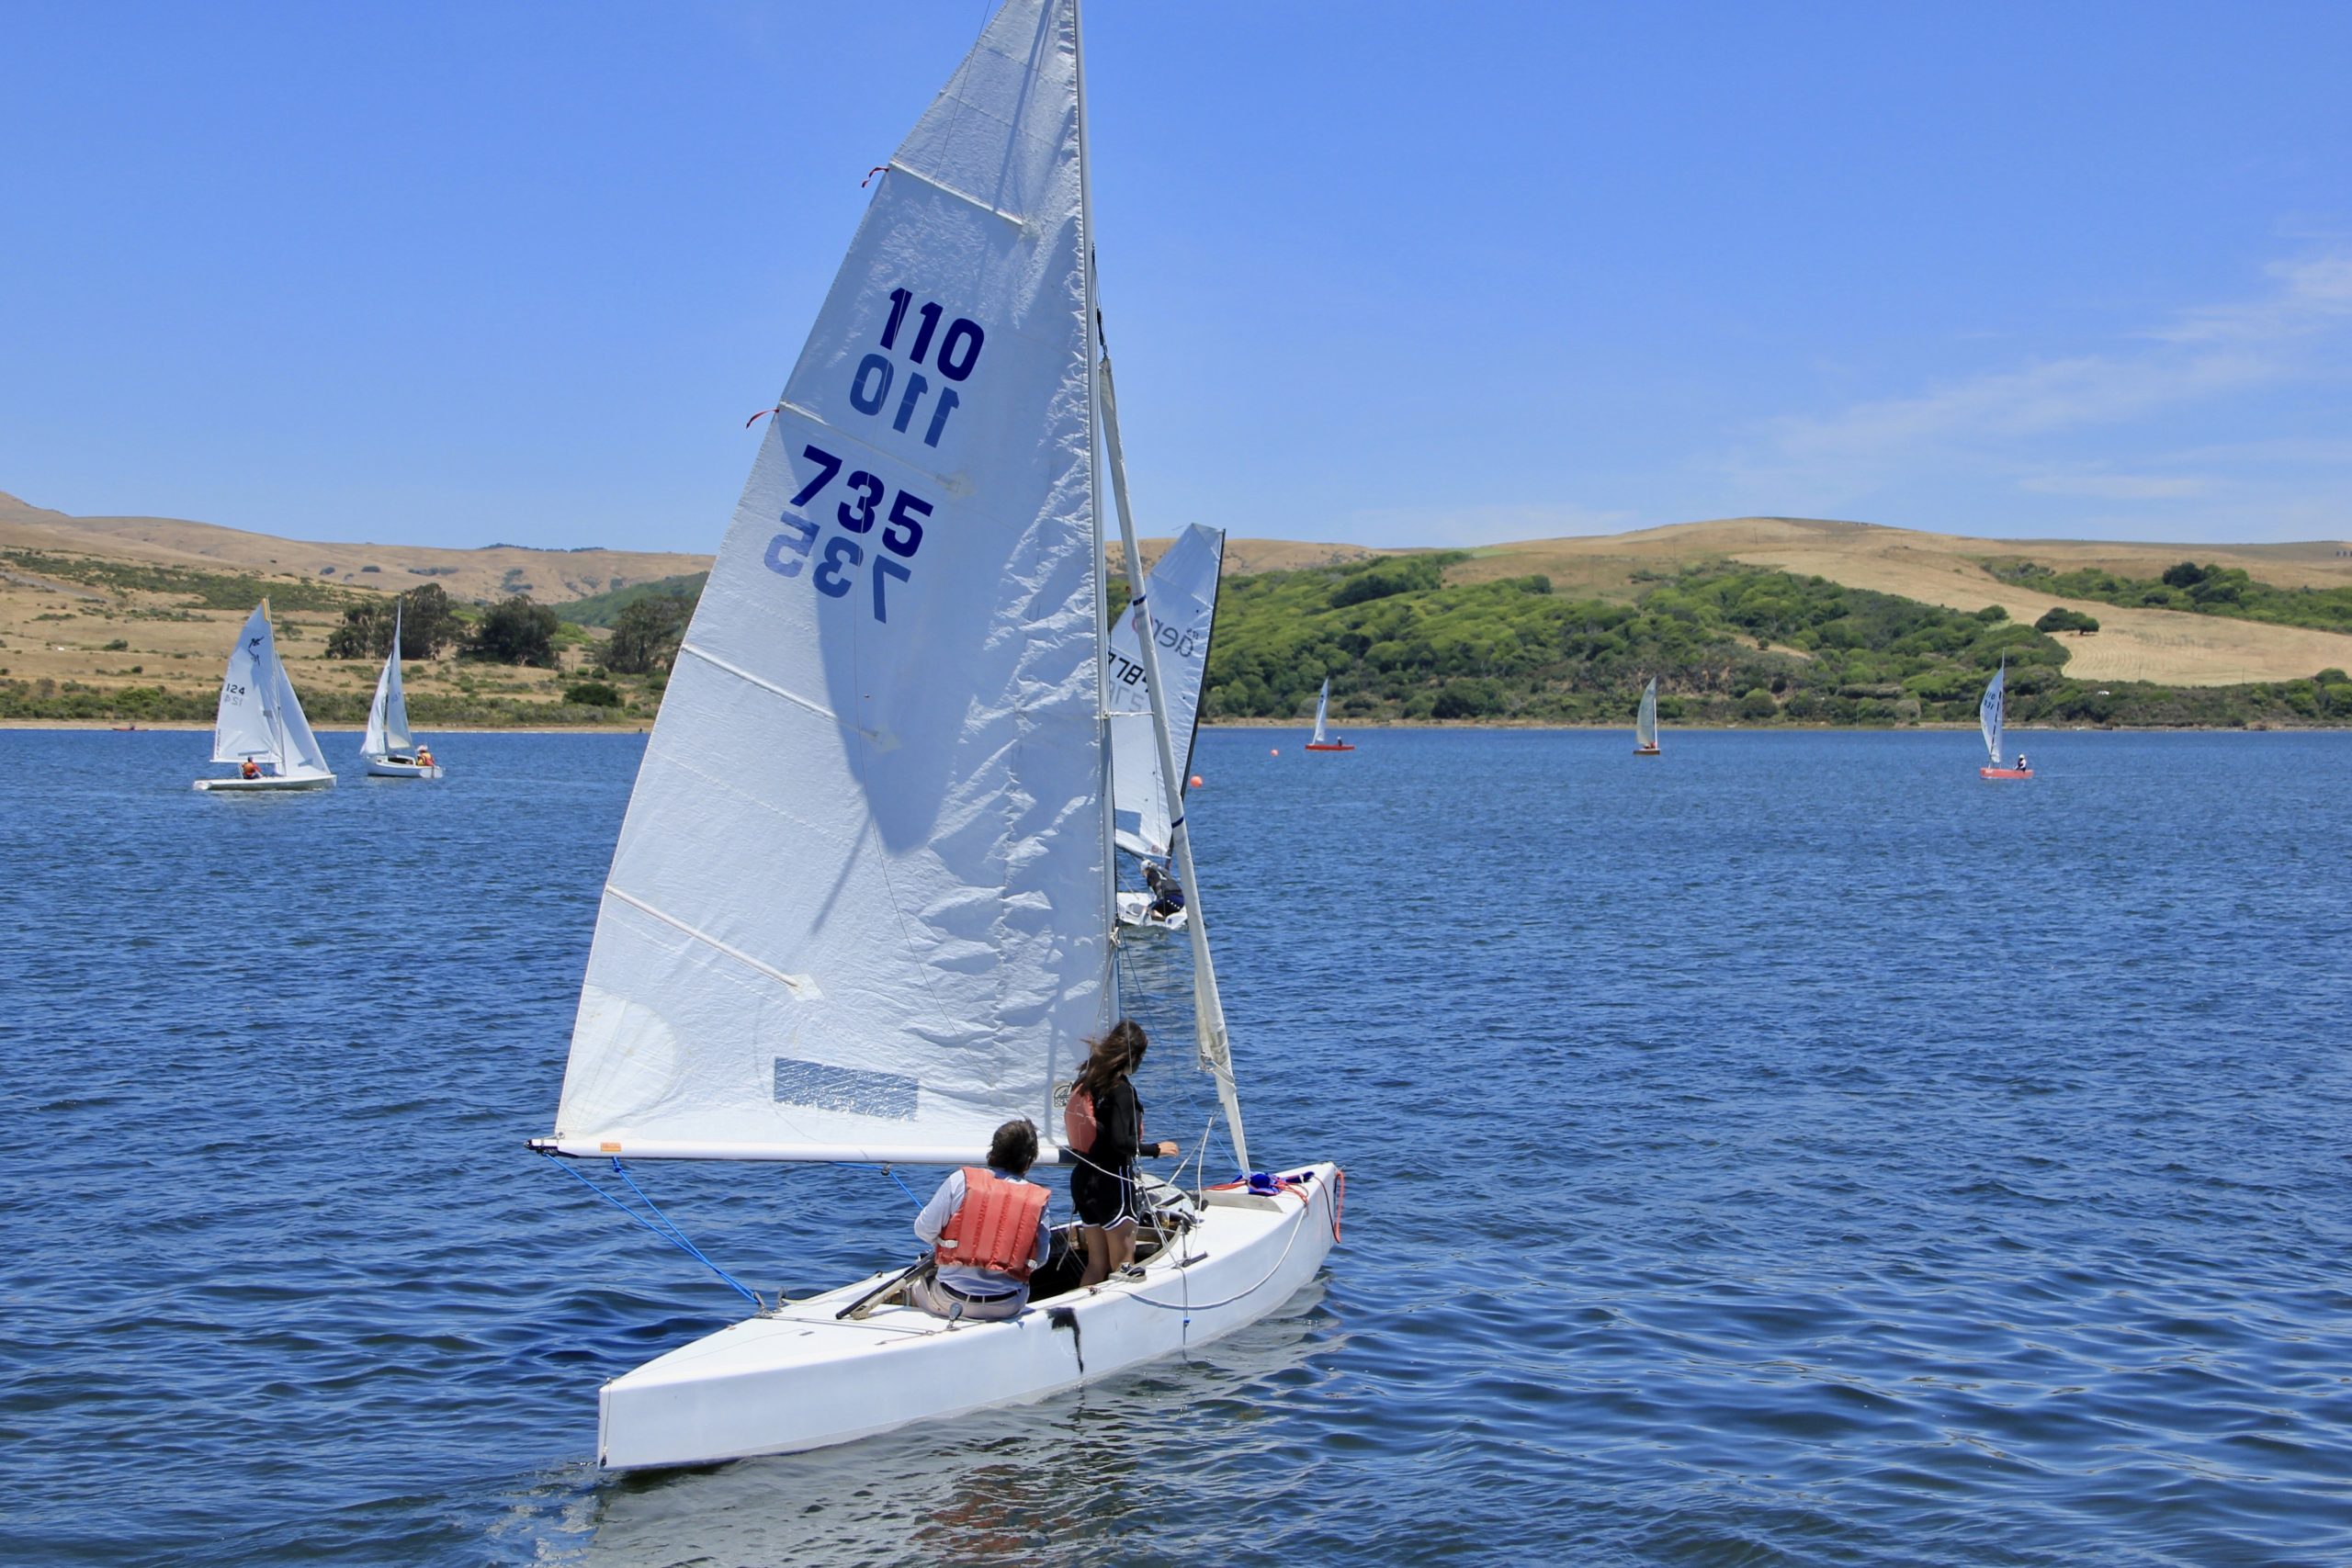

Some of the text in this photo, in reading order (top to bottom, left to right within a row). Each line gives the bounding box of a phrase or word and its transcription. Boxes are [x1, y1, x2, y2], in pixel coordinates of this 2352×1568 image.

[879, 287, 985, 382] 110
[788, 444, 934, 558] 735
[226, 682, 245, 695] 124
[1108, 650, 1149, 694] 78
